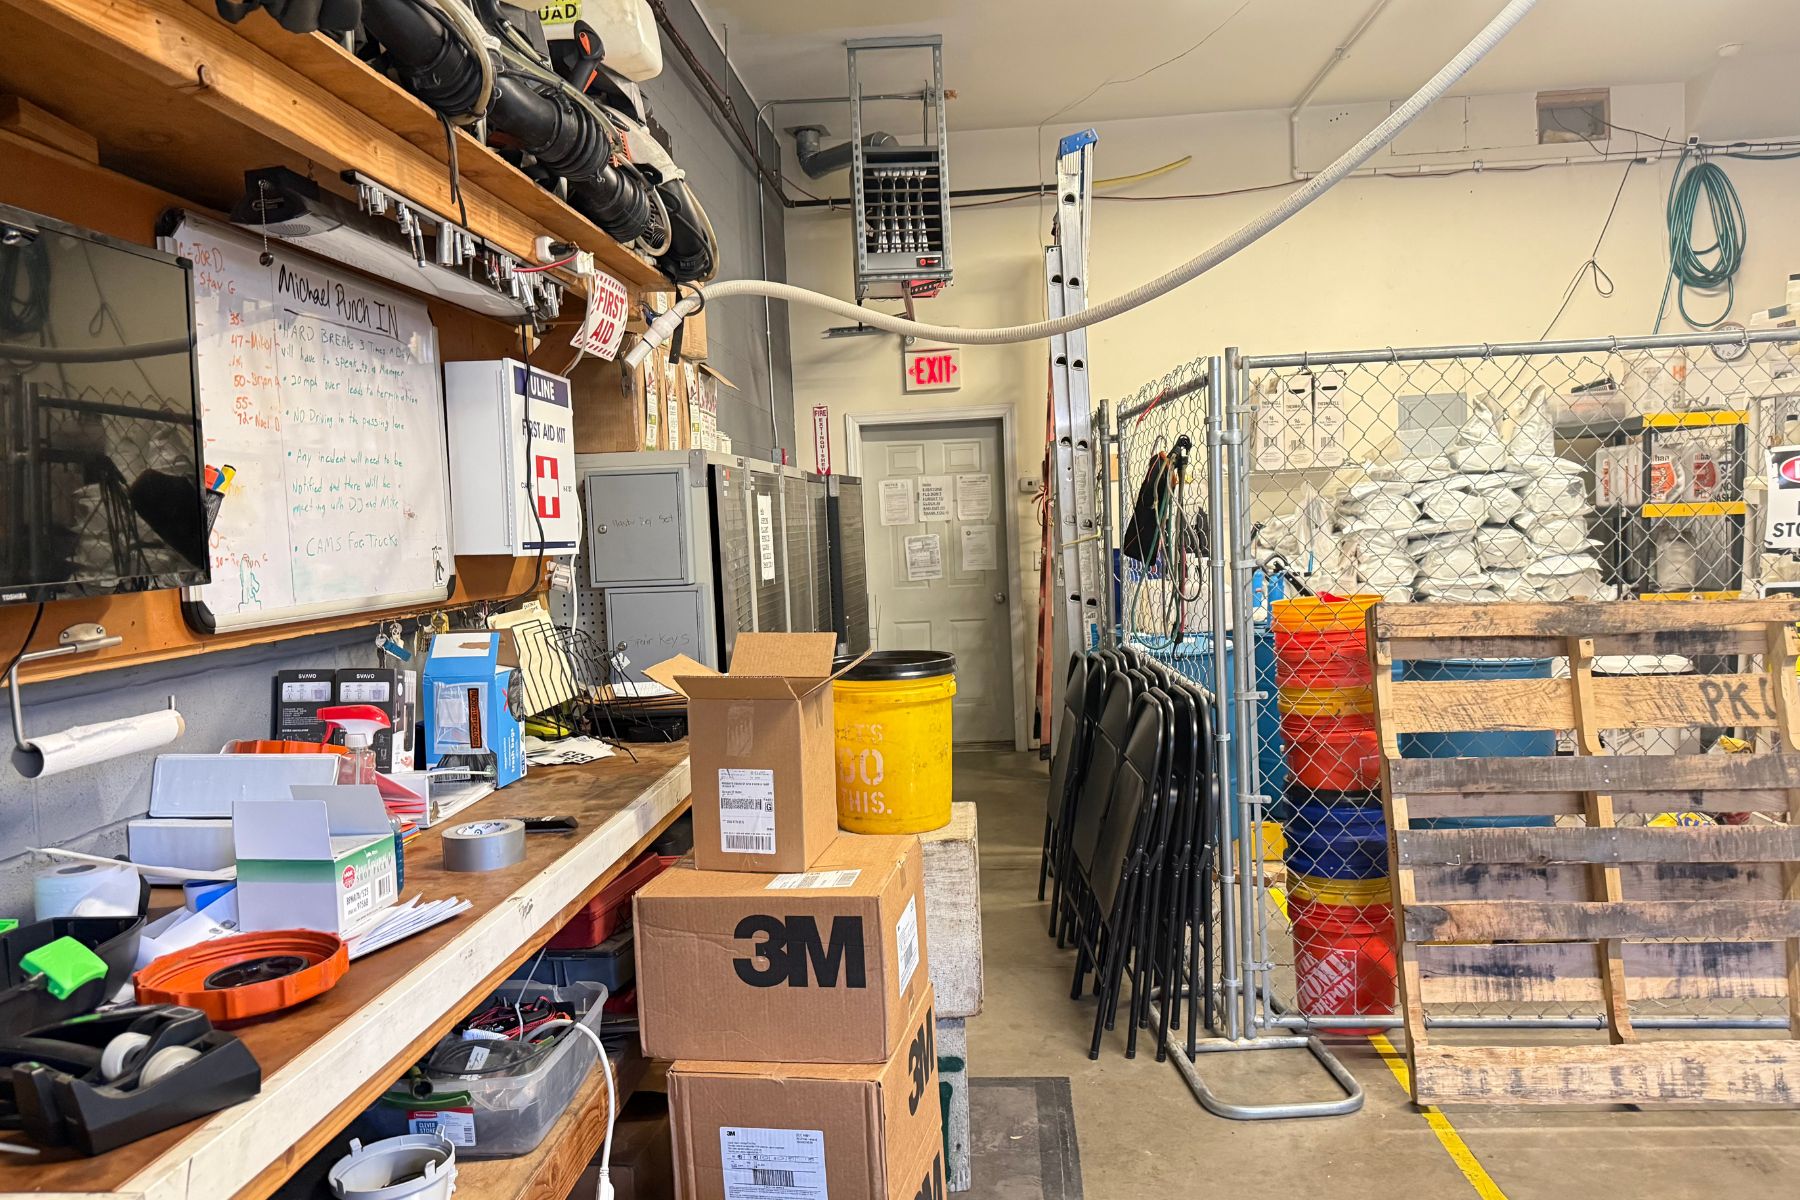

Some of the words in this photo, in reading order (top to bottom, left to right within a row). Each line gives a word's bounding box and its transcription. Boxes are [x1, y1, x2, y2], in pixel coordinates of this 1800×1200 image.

[538, 4, 577, 20] UAD
[279, 264, 331, 309] Michael
[335, 283, 371, 328] Punch
[374, 300, 399, 340] IN
[597, 286, 625, 322] FIRST
[283, 320, 315, 341] HARD
[589, 318, 615, 345] AID
[914, 354, 952, 385] EXIT
[304, 376, 317, 392] mph
[325, 380, 340, 390] over
[530, 375, 555, 400] ULINE
[310, 408, 333, 430] Driving
[338, 413, 344, 424] in
[349, 411, 359, 424] the
[362, 417, 389, 431] passing
[522, 419, 541, 439] FRST
[543, 422, 555, 441] AID
[556, 425, 566, 444] KIT
[297, 449, 311, 467] Any
[319, 448, 346, 463] incident
[351, 452, 362, 464] will
[365, 455, 380, 465] need
[384, 454, 390, 464] to
[394, 451, 403, 467] be
[344, 475, 360, 490] there
[365, 475, 379, 488] will
[349, 497, 363, 512] DJ
[306, 537, 342, 556] CAMS
[840, 748, 884, 786] DO
[733, 914, 866, 988] 3M
[908, 1005, 934, 1117] 3M
